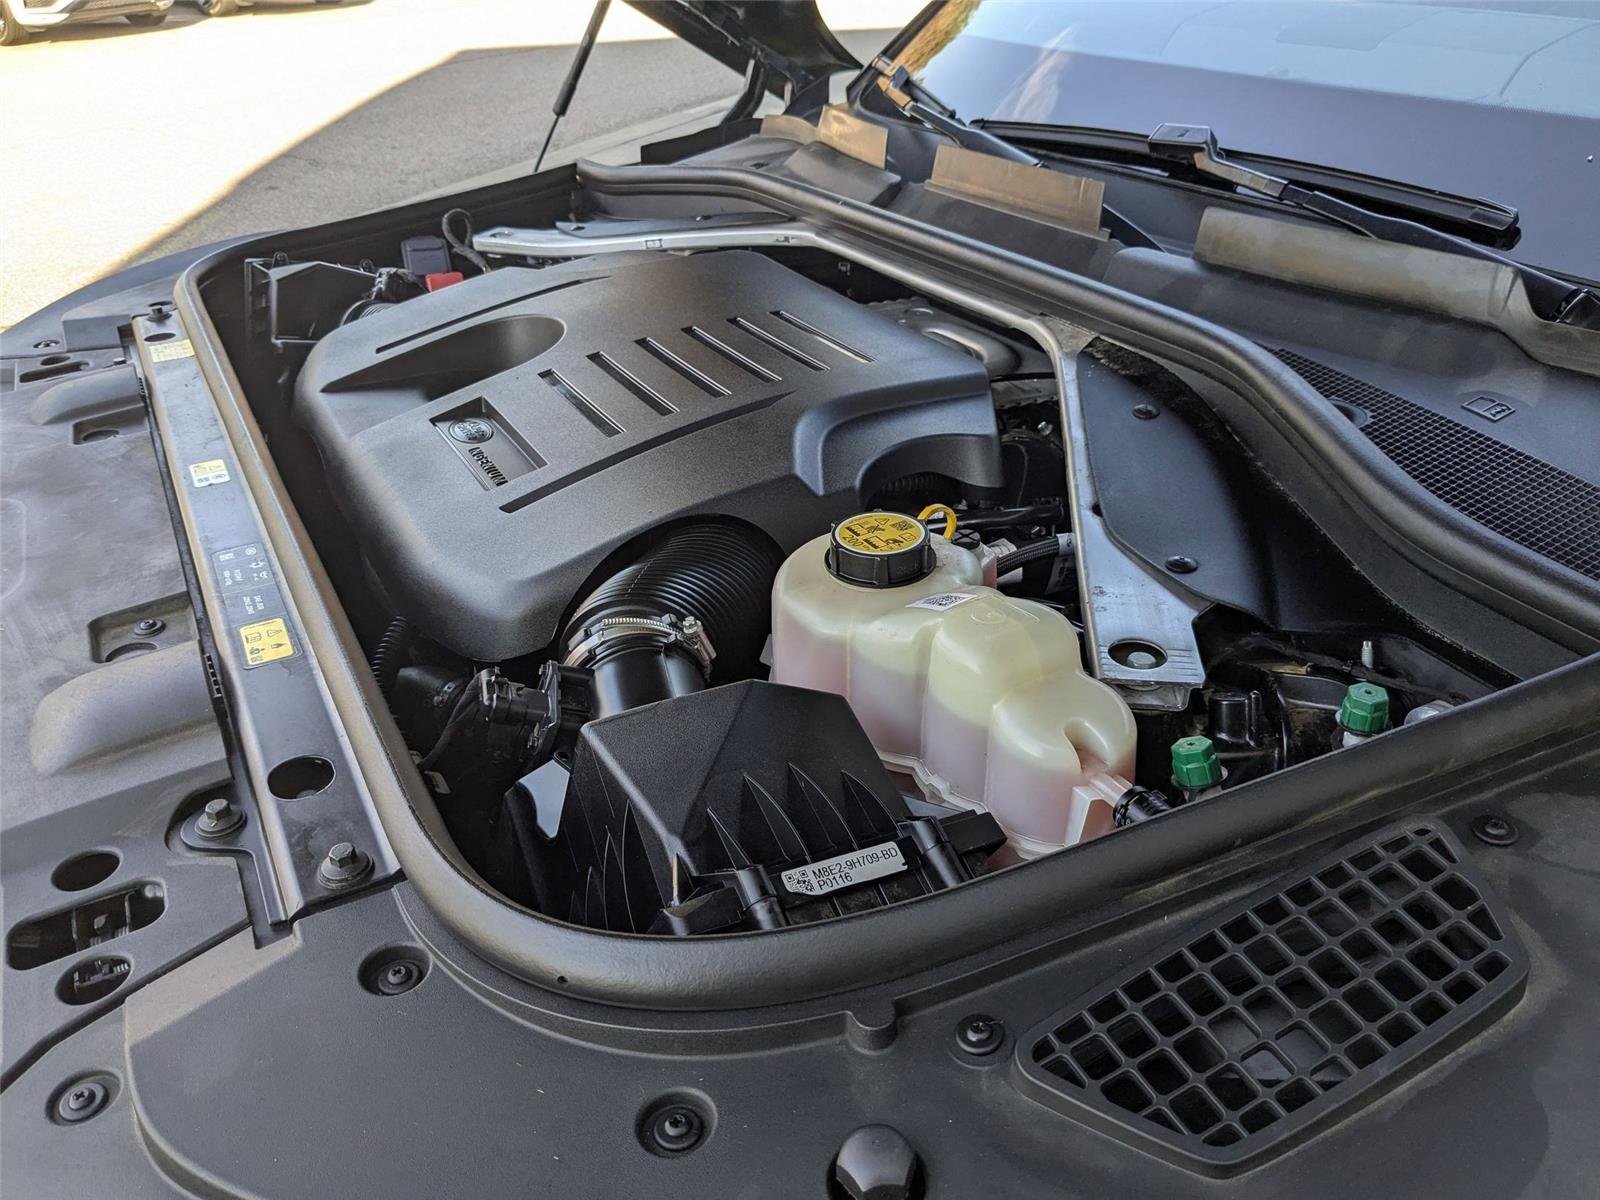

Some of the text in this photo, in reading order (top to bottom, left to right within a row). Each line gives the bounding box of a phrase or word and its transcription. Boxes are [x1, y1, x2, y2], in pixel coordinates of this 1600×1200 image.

[842, 534, 864, 547] 200
[812, 847, 898, 880] M8E2-9H709-BD
[816, 872, 853, 891] P0116
